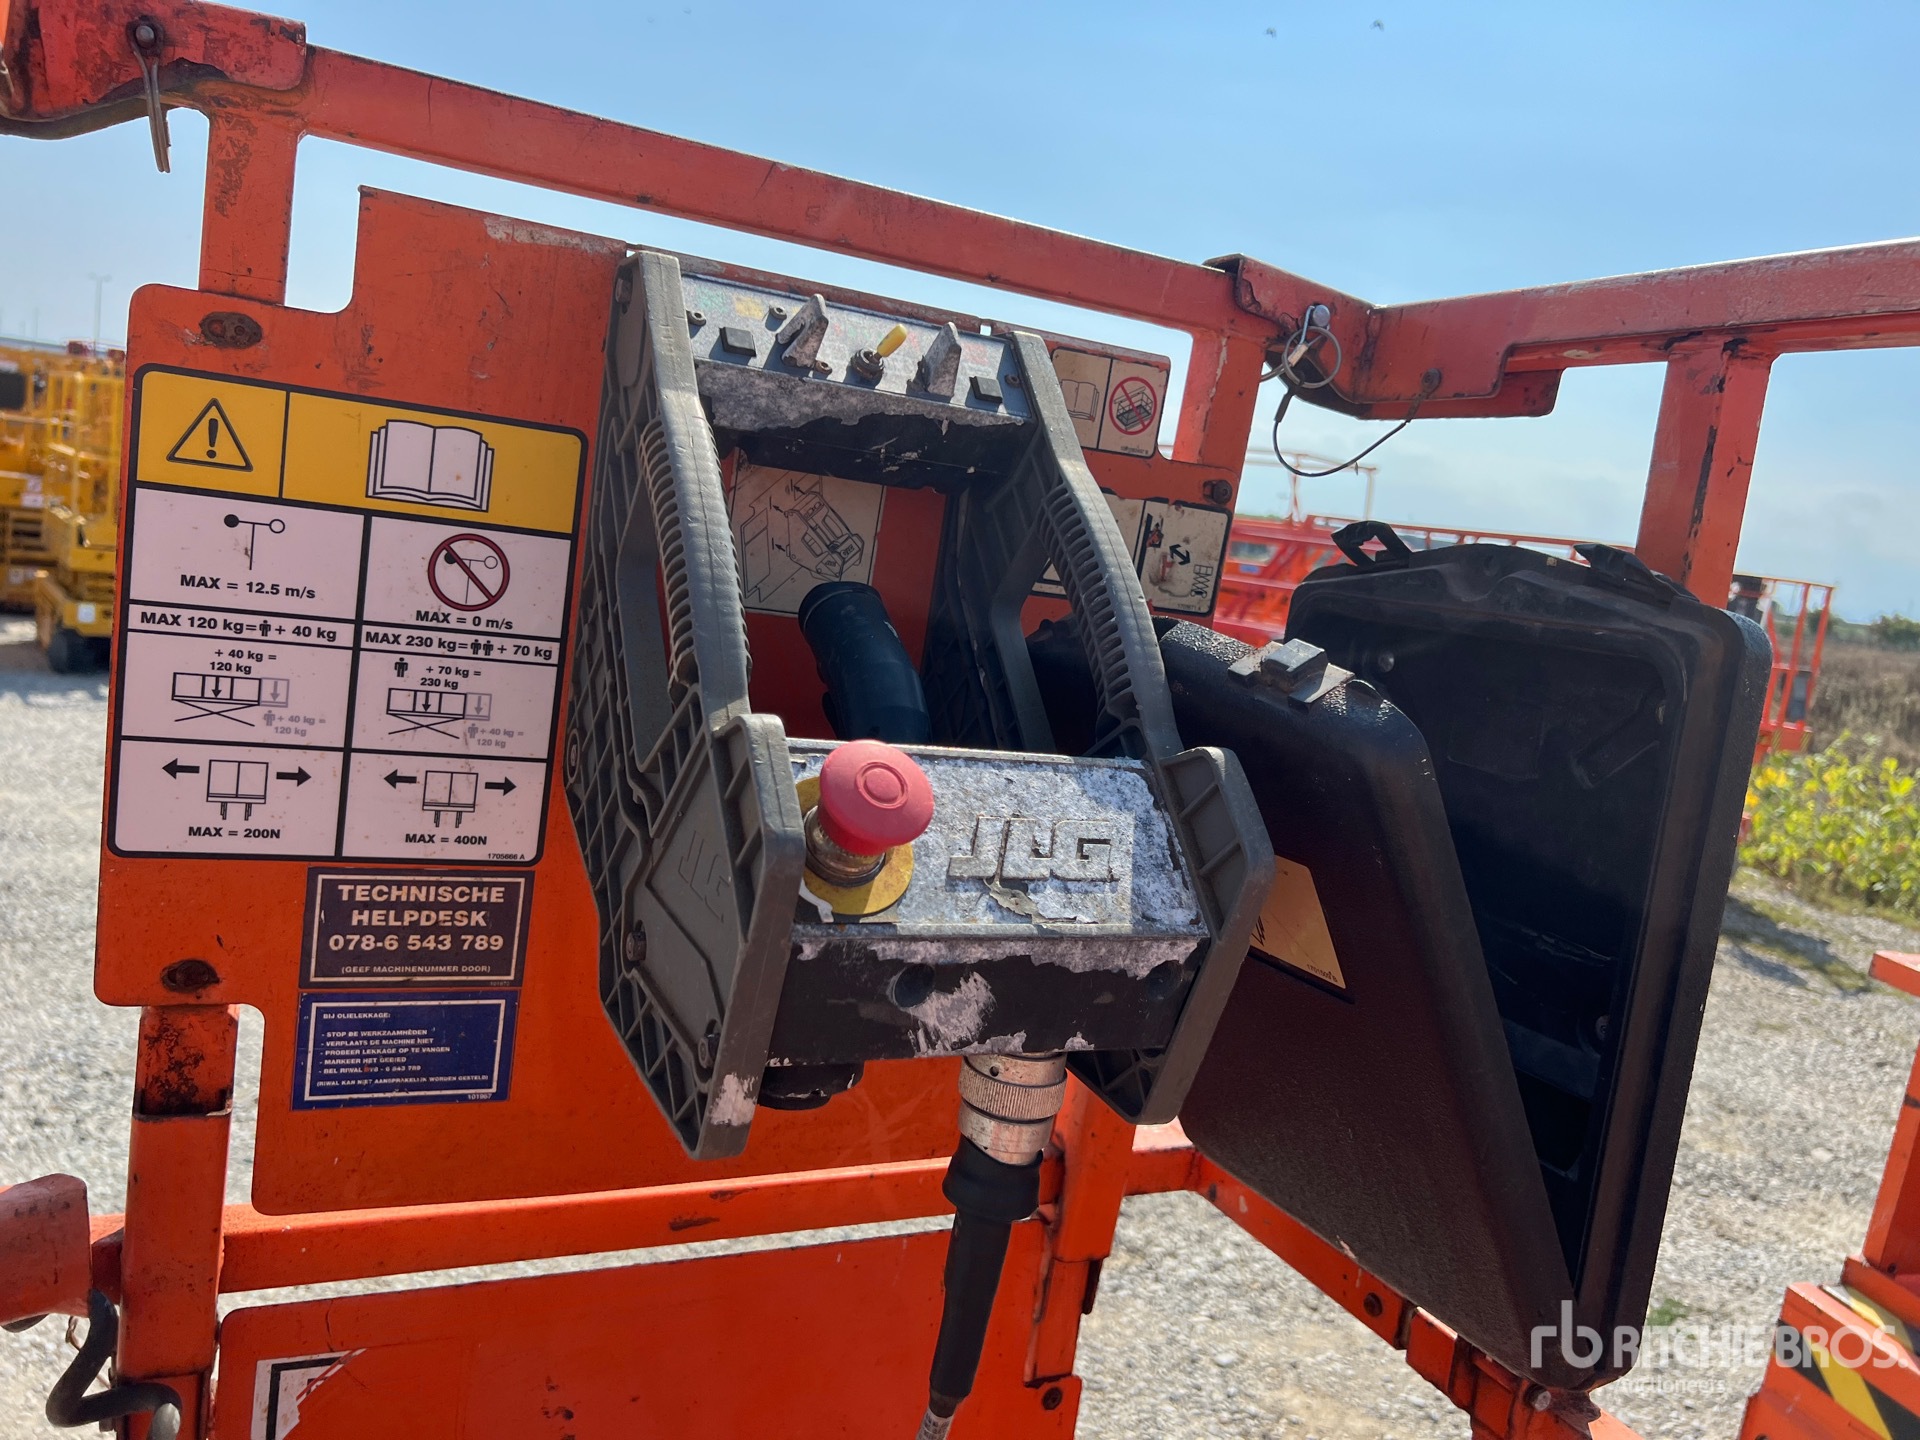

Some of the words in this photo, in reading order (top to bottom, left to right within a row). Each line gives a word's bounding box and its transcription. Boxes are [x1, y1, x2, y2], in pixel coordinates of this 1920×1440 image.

[180, 574, 221, 590] MAX
[246, 581, 280, 595] 12.5
[285, 586, 316, 599] m/s
[140, 611, 182, 626] MAX
[188, 616, 218, 629] 120
[292, 626, 312, 638] 40
[317, 627, 337, 642] kg
[415, 610, 451, 624] MAX
[472, 616, 482, 627] 0
[485, 617, 513, 630] m/s
[365, 631, 402, 645] MAX
[405, 635, 433, 648] 230
[512, 644, 530, 657] 70
[534, 646, 553, 661] kg
[228, 649, 244, 658] 40
[247, 650, 264, 662] kg
[209, 661, 232, 672] 120
[235, 663, 252, 675] kg
[438, 666, 452, 675] 70
[455, 666, 470, 678] kg
[420, 677, 441, 687] 230
[444, 678, 459, 690] kg
[288, 715, 300, 724] 40
[303, 715, 315, 726] kg
[274, 726, 292, 734] 120
[294, 726, 307, 737] kg
[489, 728, 501, 736] 40
[503, 728, 514, 738] kg
[494, 739, 506, 749] kg
[188, 826, 223, 837] MAX
[243, 828, 281, 839] 200N
[405, 833, 436, 844] MAX
[454, 835, 488, 845] 400N
[337, 884, 505, 903] TECHNISCHE
[351, 910, 488, 927] HELPDESK
[329, 934, 399, 951] 078-6
[407, 934, 452, 950] 543
[460, 934, 504, 950] 789
[341, 966, 371, 974] (GEEF
[373, 965, 459, 973] MACHINENUMMER
[461, 965, 491, 973] DOOR)
[326, 1039, 368, 1047] VERPLAATS
